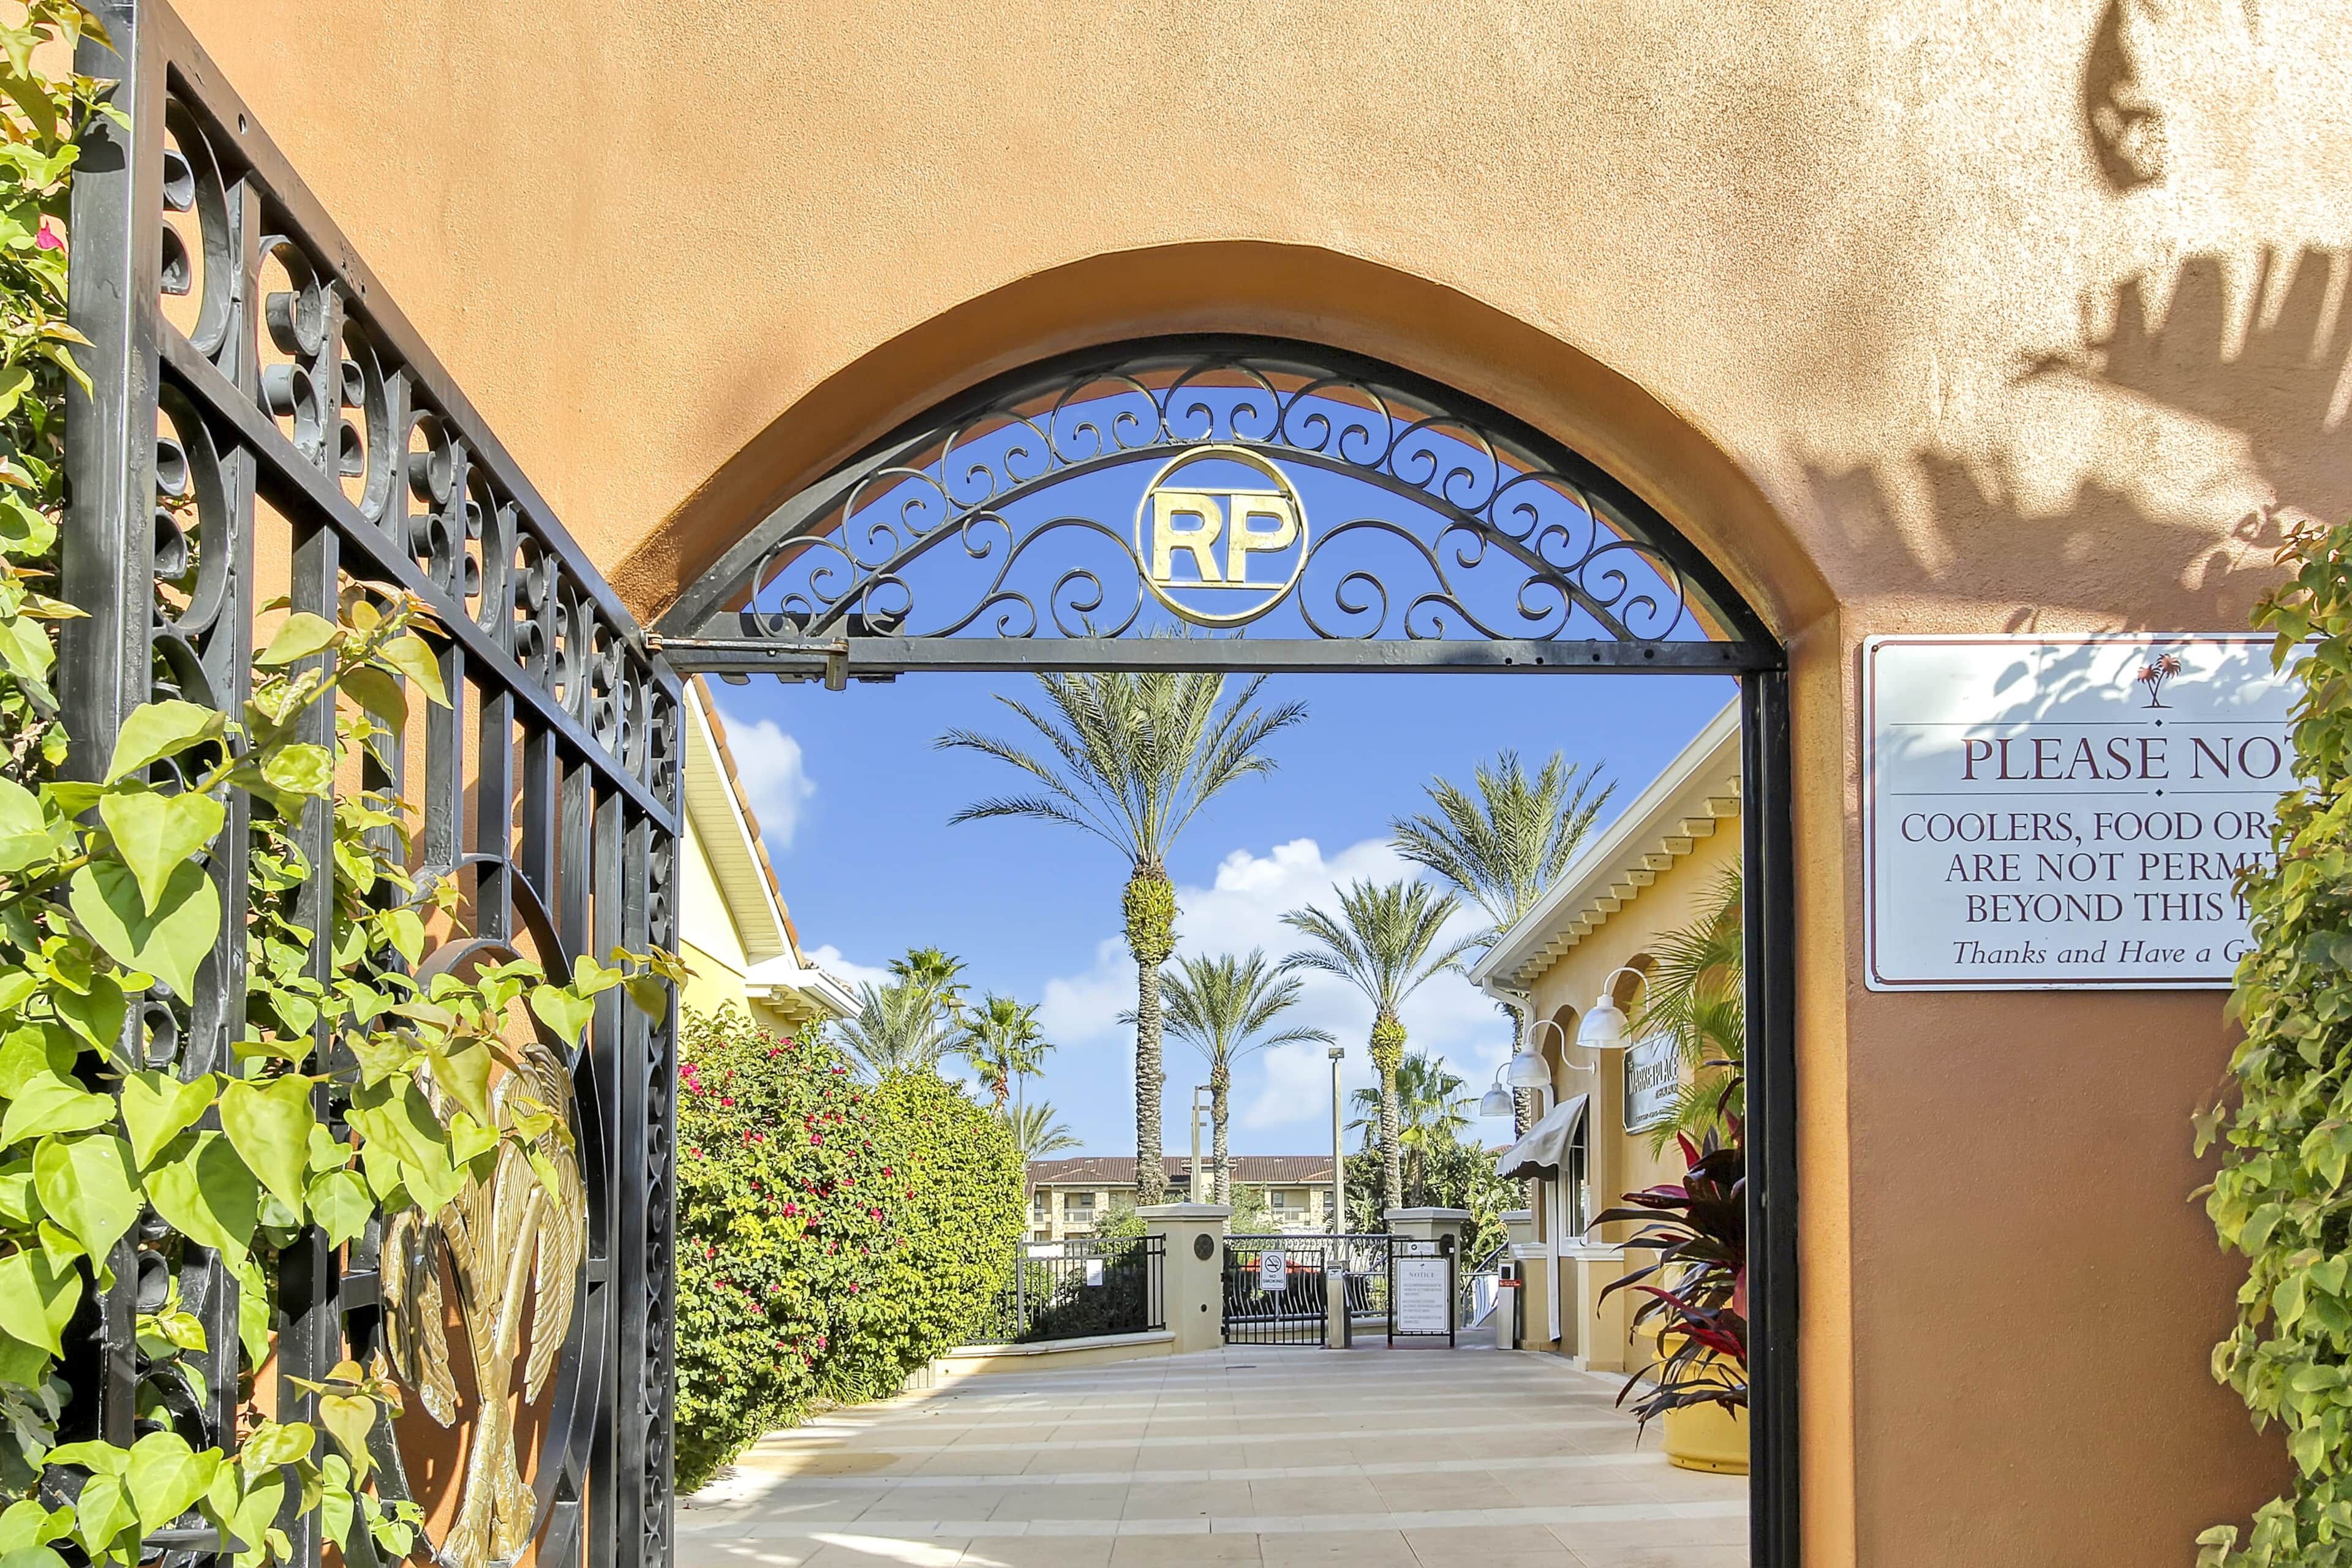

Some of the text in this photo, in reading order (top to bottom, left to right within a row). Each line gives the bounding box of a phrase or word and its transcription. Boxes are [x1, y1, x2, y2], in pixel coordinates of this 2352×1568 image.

[1153, 492, 1299, 582] RP
[1961, 735, 2293, 780] PLEASE NO
[1901, 811, 2272, 848] COOLERS, FOOD OR
[1944, 853, 2021, 882] ARE
[2036, 852, 2124, 882] NOT
[1965, 893, 2124, 922] BEYOND
[2134, 892, 2223, 922] THIS
[1953, 940, 2047, 964] Thanks
[2057, 940, 2108, 963] and
[2117, 940, 2185, 963] Have
[2196, 949, 2211, 963] a
[1628, 1055, 1679, 1096] MARKETPLACE
